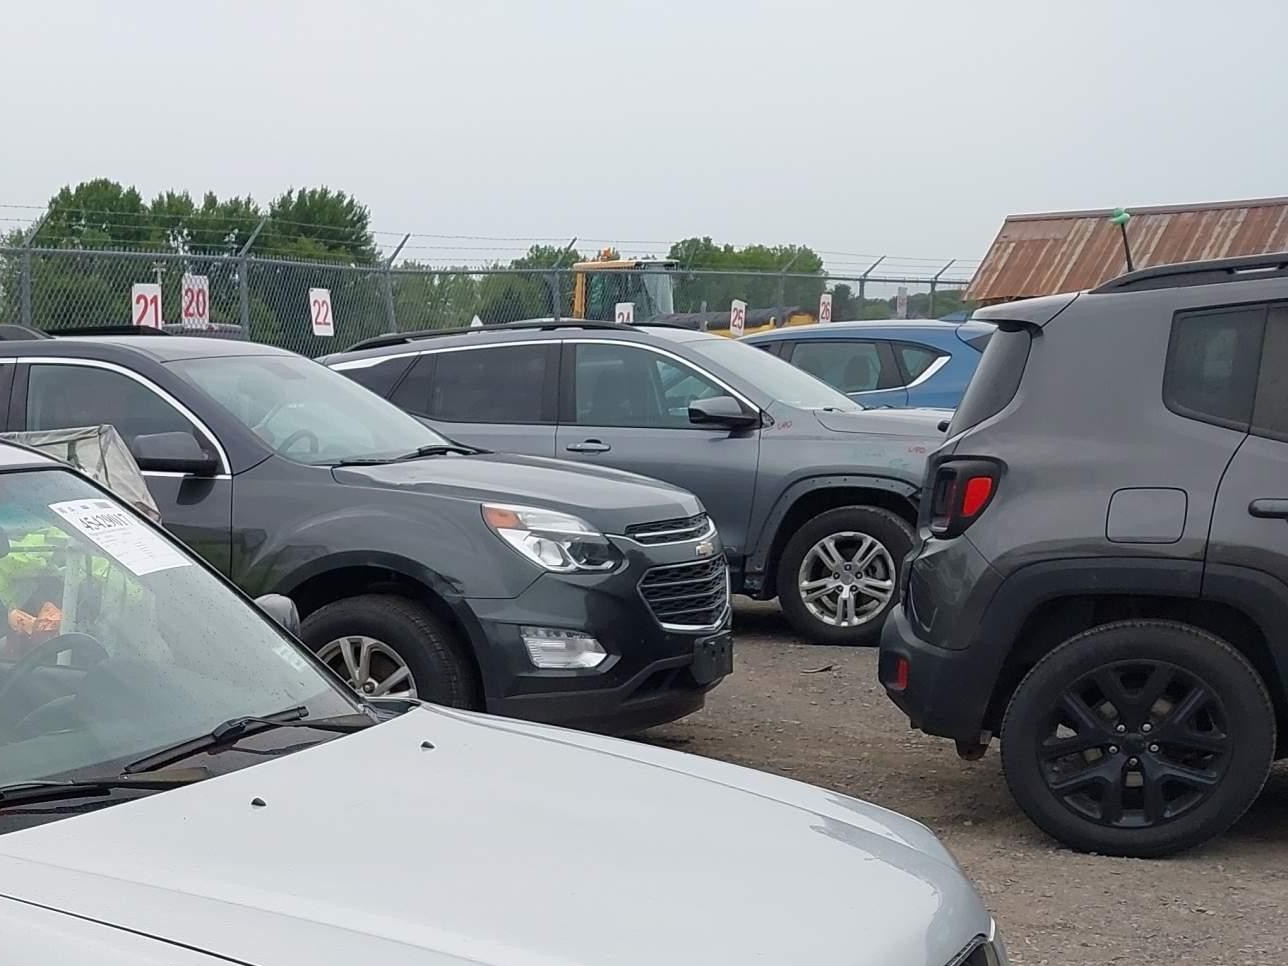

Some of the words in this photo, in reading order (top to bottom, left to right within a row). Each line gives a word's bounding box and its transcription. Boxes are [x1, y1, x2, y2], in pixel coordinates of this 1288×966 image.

[135, 294, 159, 329] 21
[184, 287, 207, 318] 20
[313, 299, 331, 326] 22
[821, 301, 831, 321] 26
[732, 307, 744, 330] 25
